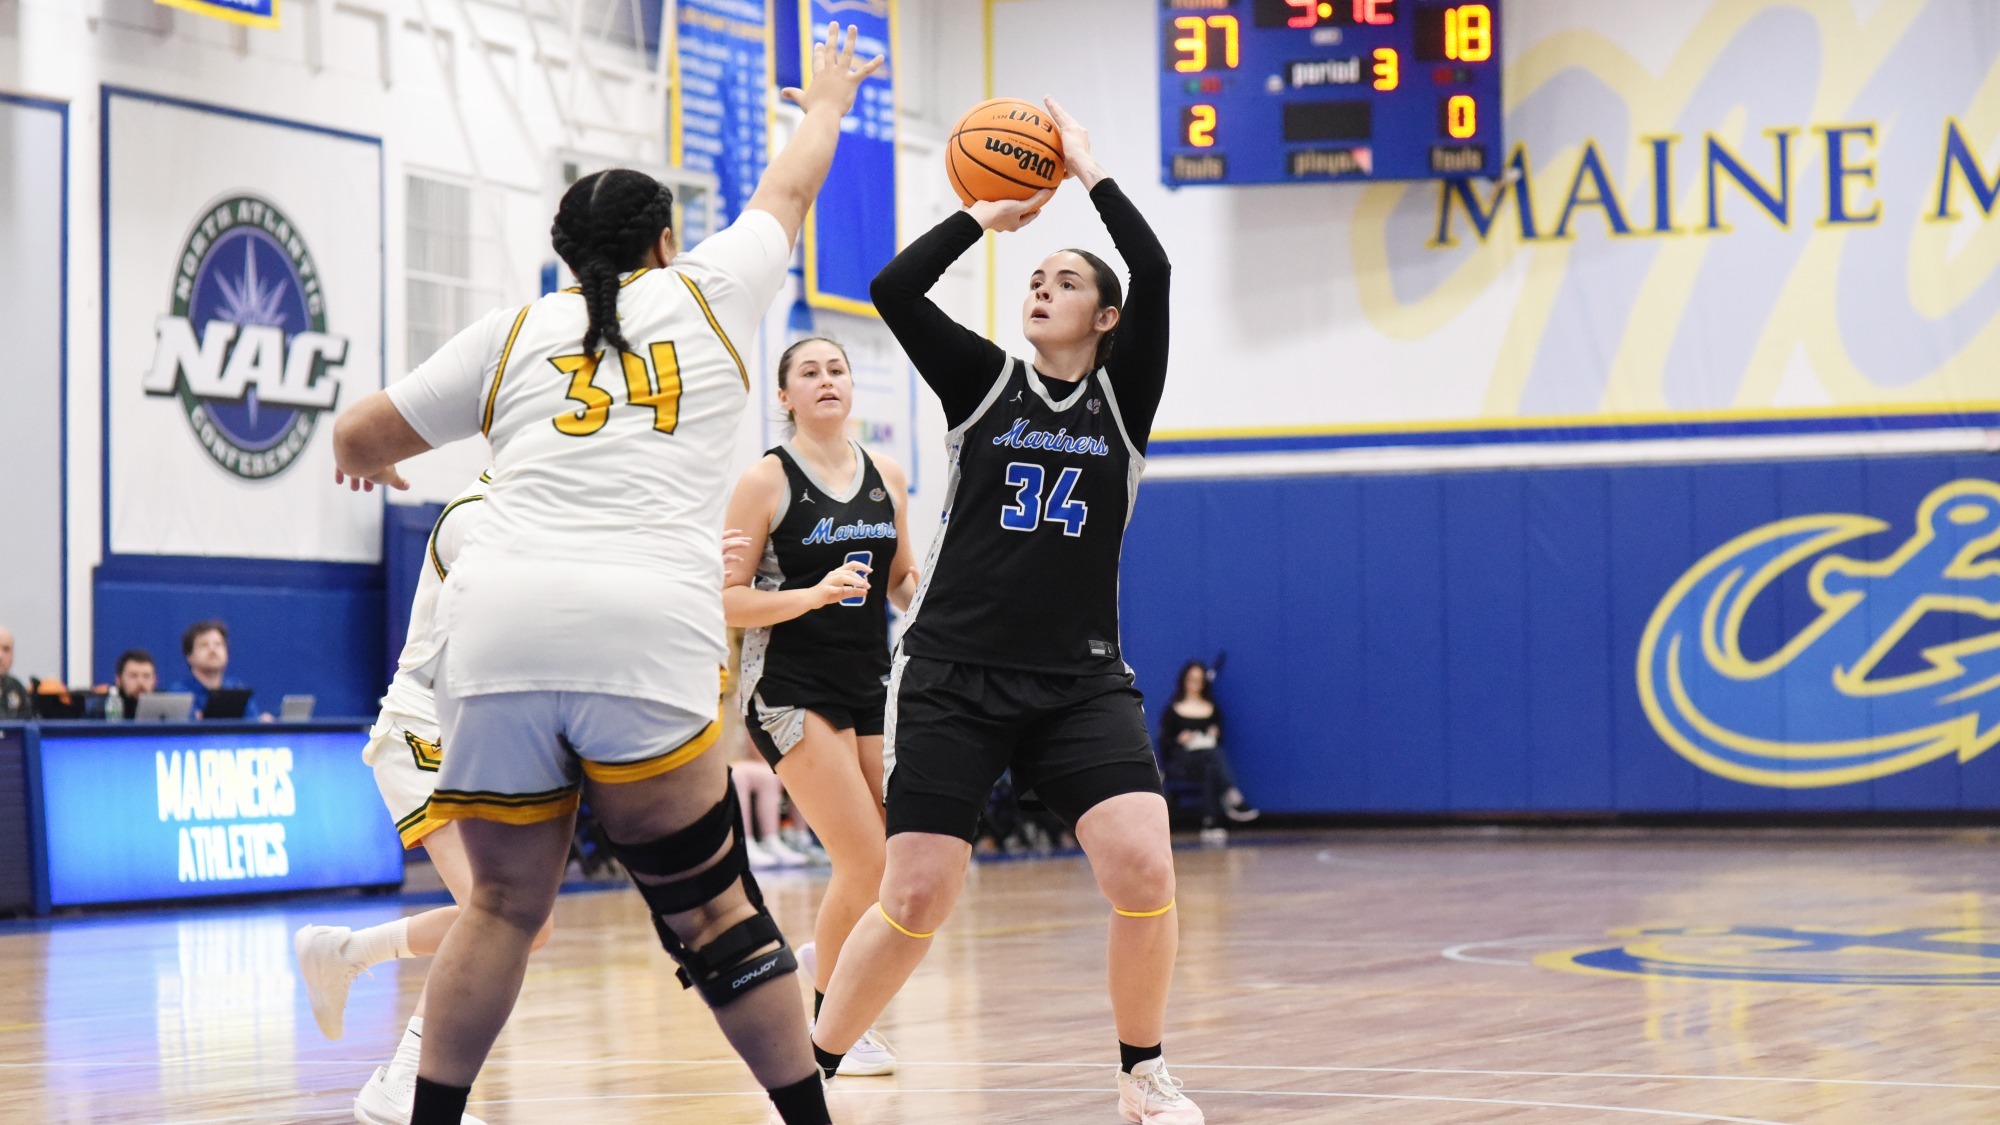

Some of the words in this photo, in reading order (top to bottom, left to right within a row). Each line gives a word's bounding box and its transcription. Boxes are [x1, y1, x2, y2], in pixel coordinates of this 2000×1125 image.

[1174, 14, 1239, 73] 37
[1444, 4, 1492, 62] 18
[1291, 57, 1360, 88] period
[1372, 47, 1399, 92] 3
[1188, 104, 1217, 147] 2
[1447, 94, 1477, 139] 0
[985, 137, 1056, 181] Wilson
[1294, 149, 1357, 175] playe
[1426, 120, 1883, 249] MAINE
[175, 203, 233, 302] NORTH
[237, 199, 321, 316] ATLANTIC
[143, 313, 349, 411] NAC
[547, 340, 683, 437] 34
[191, 404, 313, 477] CONFERENCE
[992, 417, 1109, 456] Mariners
[1000, 461, 1089, 538] 34
[155, 747, 297, 822] MARINERS
[178, 822, 289, 883] ATHLETICS
[731, 956, 779, 990] DONJOY
